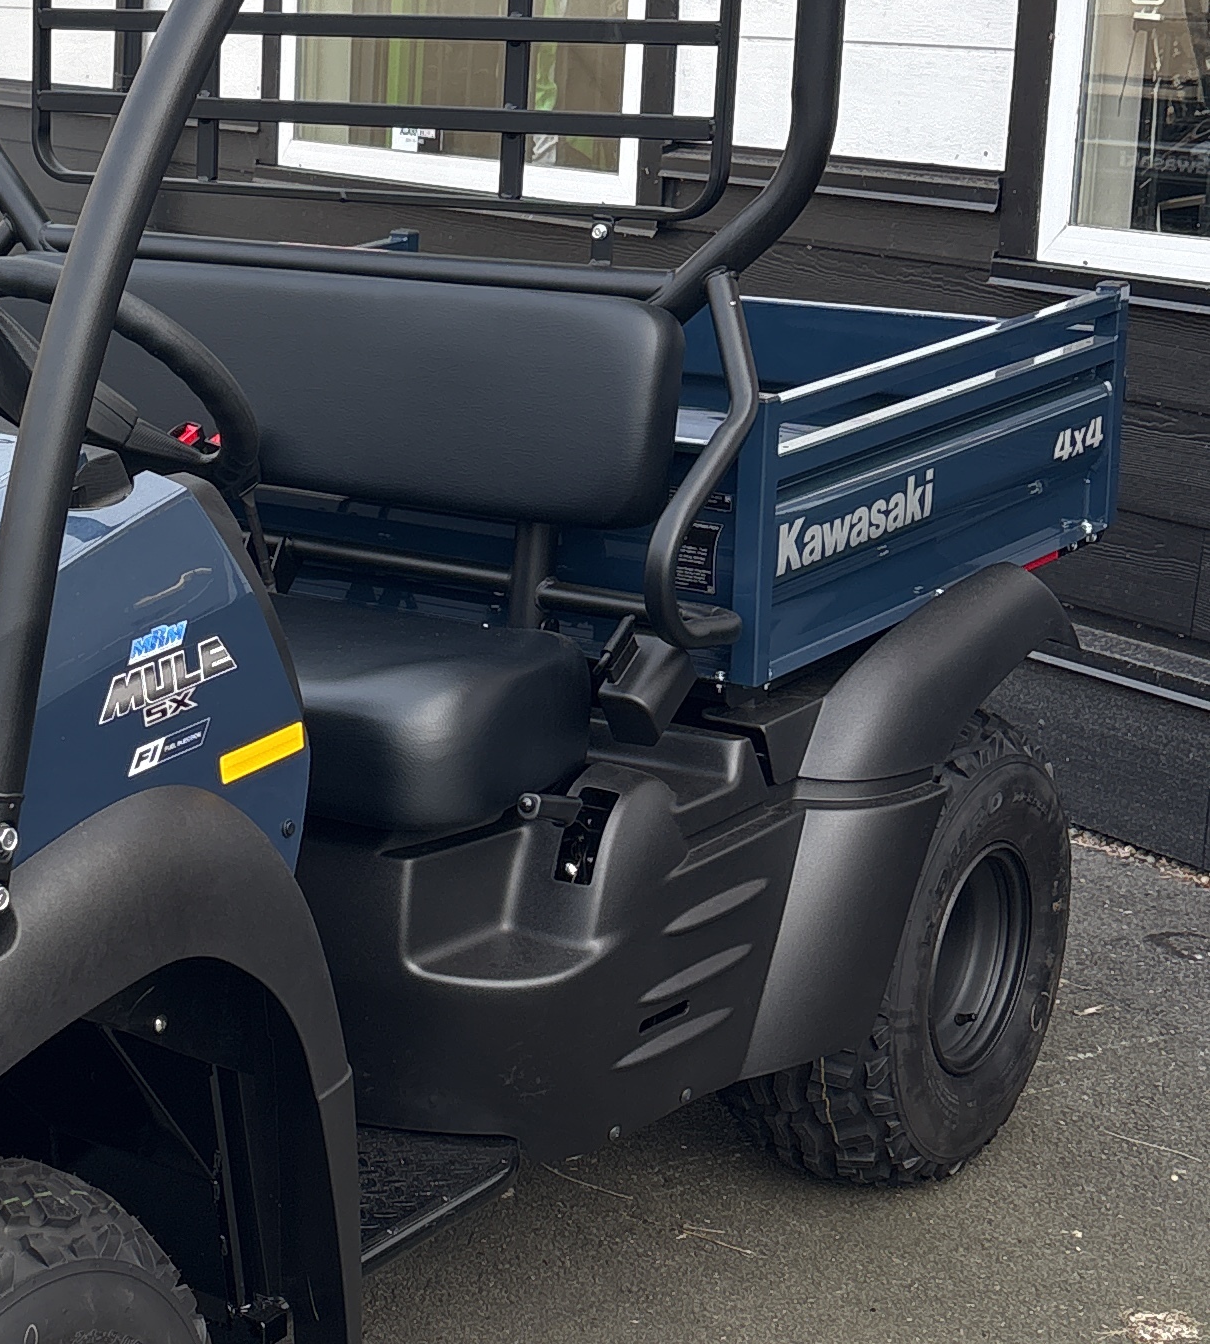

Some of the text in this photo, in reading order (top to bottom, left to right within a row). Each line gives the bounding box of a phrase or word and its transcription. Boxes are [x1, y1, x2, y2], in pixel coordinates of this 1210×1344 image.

[1053, 415, 1104, 462] 4x4
[775, 467, 935, 578] Kawasaki
[99, 636, 237, 724] MULE
[143, 687, 198, 727] SX
[133, 740, 162, 770] FI
